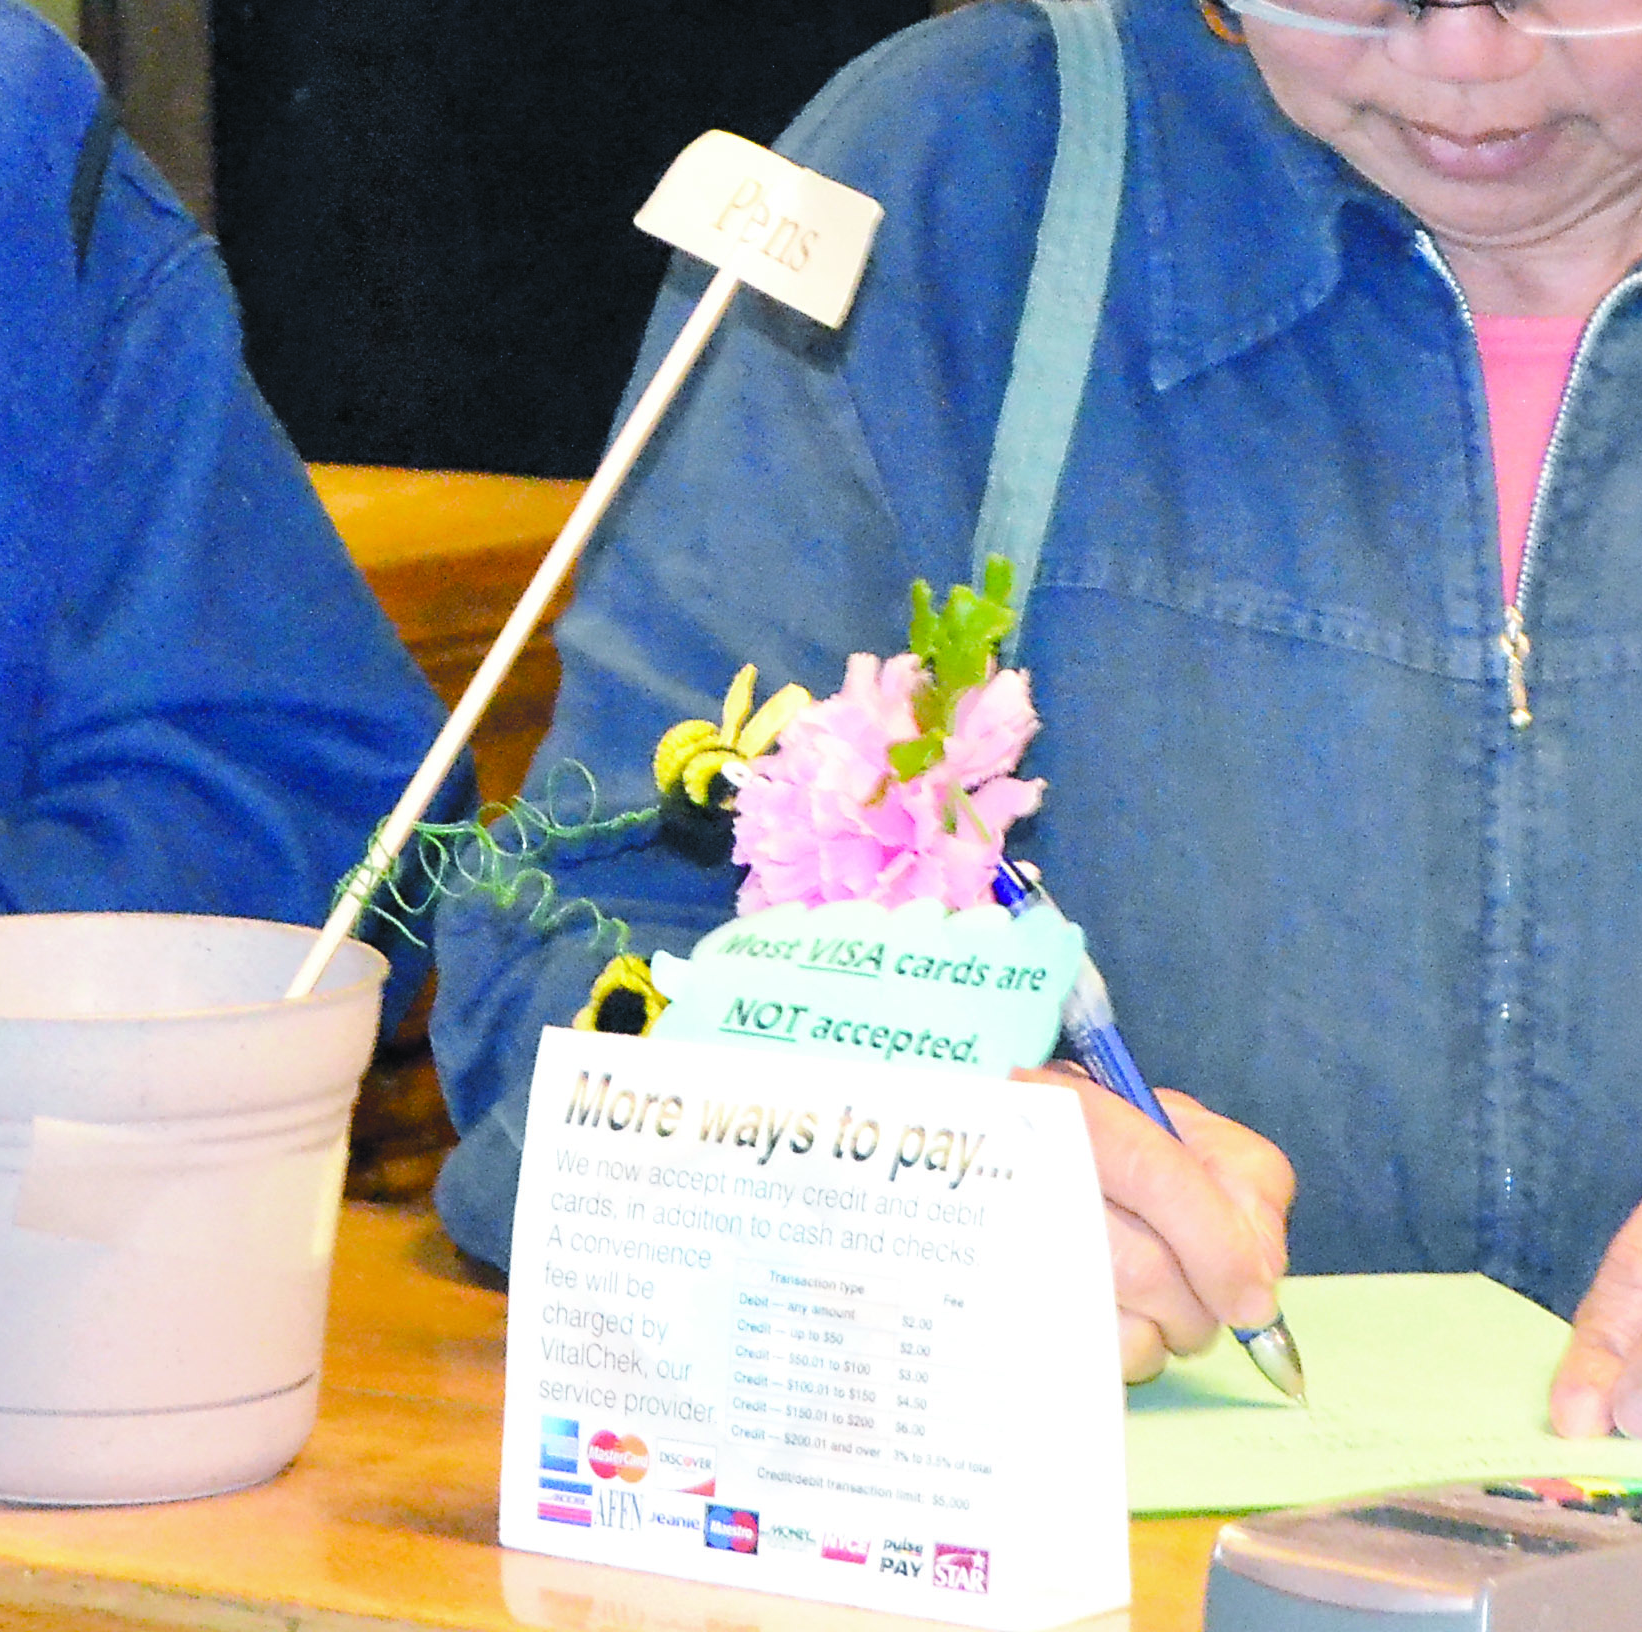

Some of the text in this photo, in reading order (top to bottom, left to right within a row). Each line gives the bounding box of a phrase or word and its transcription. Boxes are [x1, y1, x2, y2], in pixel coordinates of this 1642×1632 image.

[720, 933, 1046, 992] Most VISA cards are
[723, 997, 979, 1064] NOT accepted.
[565, 1070, 1013, 1190] More ways to pay...
[557, 1149, 985, 1228] We now accept many credit and debit
[547, 1225, 712, 1269] A convenience
[551, 1188, 980, 1268] cards, in addition to cash and checks.
[545, 1260, 654, 1300] fee will be
[770, 1270, 964, 1308] Transaction type Fee
[543, 1301, 669, 1345] charged by
[739, 1293, 769, 1308] Debit
[811, 1305, 855, 1320] amount
[737, 1319, 771, 1335] Credit
[542, 1336, 692, 1381] VitalChek, our
[735, 1345, 769, 1361] Credit
[734, 1371, 768, 1387] Credit
[540, 1379, 717, 1424] service provider.
[732, 1397, 767, 1413] Credit
[731, 1424, 765, 1441] Credit
[827, 1479, 892, 1499] transaction
[595, 1489, 644, 1530] AFFN
[933, 1562, 989, 1593] STAR
[883, 1537, 923, 1554] pulse
[879, 1556, 924, 1578] PAY
